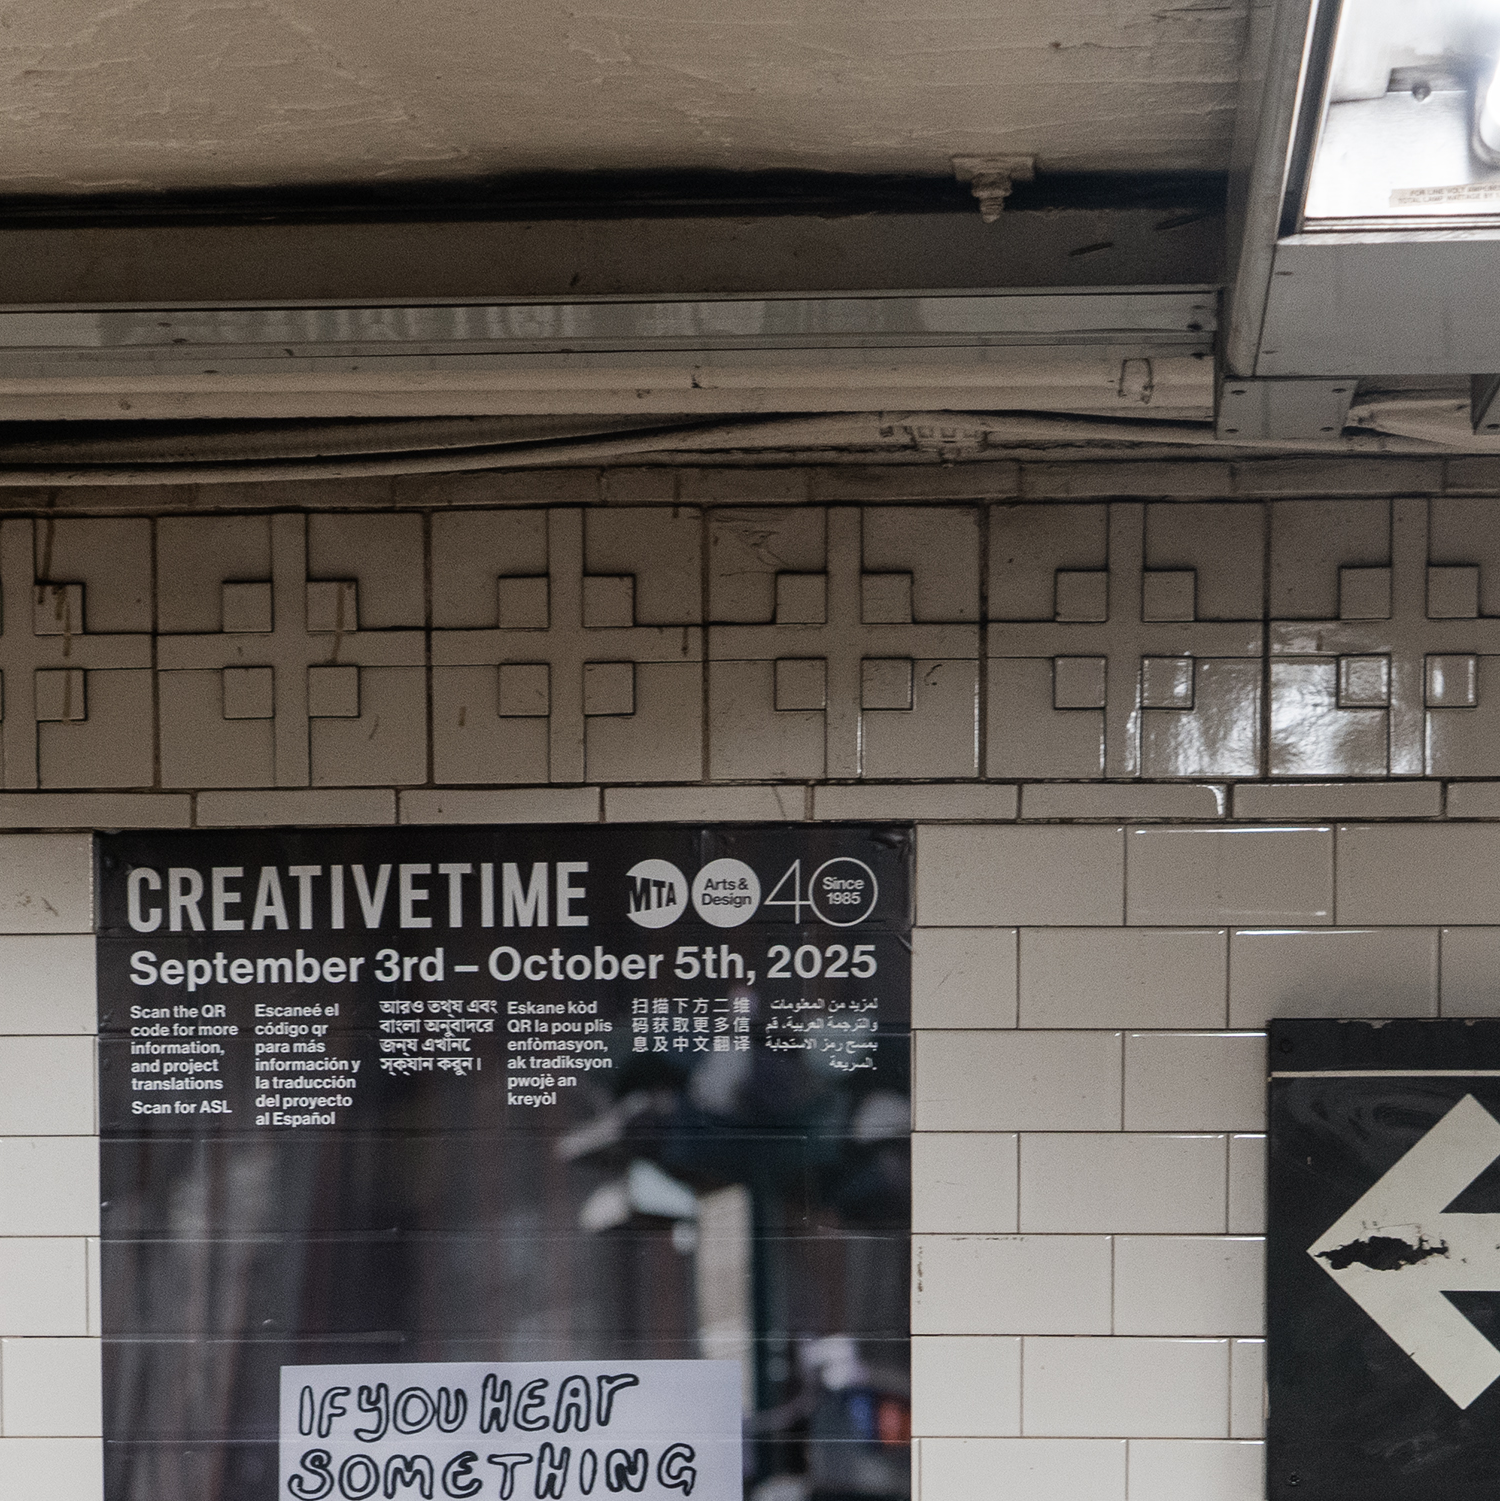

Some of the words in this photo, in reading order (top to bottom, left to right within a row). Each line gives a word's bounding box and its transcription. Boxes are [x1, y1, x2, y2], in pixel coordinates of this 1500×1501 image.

[704, 878, 737, 891] Arts
[739, 878, 748, 890] &
[822, 877, 865, 890] Since
[128, 862, 588, 932] CREATIVETIME
[629, 876, 677, 914] MTA
[702, 894, 752, 907] Design
[826, 892, 861, 904] 1985
[130, 949, 365, 991] September
[375, 948, 444, 982] 3rd
[489, 946, 663, 981] October
[674, 945, 755, 985] 5th,
[767, 945, 877, 978] 2025
[130, 1006, 170, 1018] Scan
[173, 1005, 198, 1018] the
[202, 1005, 225, 1017] QR
[255, 1004, 322, 1017] Escaneé
[325, 1004, 339, 1016] el
[508, 1002, 565, 1014] Eskane
[568, 1001, 597, 1013] kòd
[631, 998, 750, 1014] 扫描下方二维
[131, 1024, 169, 1036] code
[172, 1023, 195, 1036] for
[199, 1026, 238, 1035] more
[255, 1022, 308, 1037] código
[312, 1025, 328, 1037] qr
[507, 1020, 531, 1032] QR
[535, 1020, 548, 1032] la
[552, 1023, 581, 1034] pou
[585, 1019, 612, 1034] plis
[631, 1017, 750, 1034] 码获取更多信
[131, 1041, 224, 1055] information,
[256, 1043, 290, 1055] para
[293, 1039, 325, 1052] más
[508, 1038, 608, 1052] enfòmasyon,
[631, 1036, 750, 1052] 息及中文翻译
[131, 1059, 160, 1072] and
[163, 1059, 218, 1074] project
[256, 1057, 348, 1071] información
[351, 1061, 360, 1072] y
[508, 1056, 526, 1069] ak
[529, 1056, 612, 1071] tradiksyon
[131, 1077, 223, 1090] translations
[256, 1076, 269, 1089] la
[272, 1076, 356, 1089] traducción
[508, 1074, 554, 1089] pwojè
[558, 1077, 576, 1086] an
[132, 1101, 171, 1114] Scan
[174, 1101, 197, 1113] for
[200, 1100, 232, 1113] ASL
[256, 1094, 279, 1107] del
[283, 1094, 352, 1109] proyecto
[508, 1092, 556, 1107] kreyòl
[256, 1112, 269, 1125] al
[273, 1112, 335, 1127] Español
[287, 1442, 696, 1501] SOMETHING
